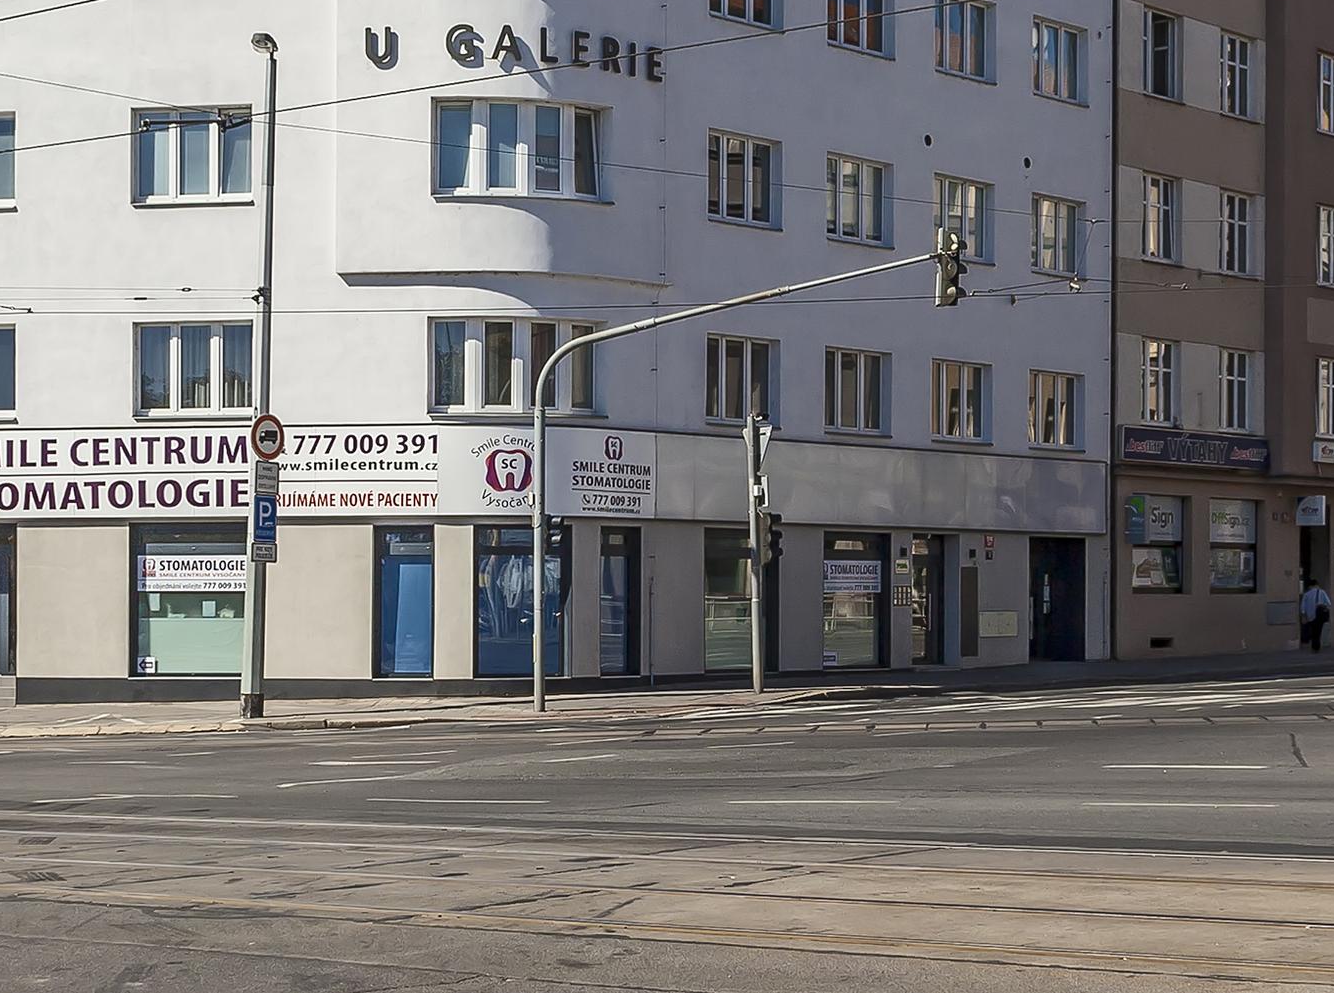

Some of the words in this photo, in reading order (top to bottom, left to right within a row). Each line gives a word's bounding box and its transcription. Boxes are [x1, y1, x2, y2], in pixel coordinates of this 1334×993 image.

[365, 26, 394, 63] U
[446, 24, 664, 83] GALERIE
[70, 436, 249, 467] CENTRUM
[293, 435, 337, 455] 777
[344, 434, 389, 455] 009
[395, 434, 438, 455] 391
[471, 437, 500, 458] Smile
[503, 435, 536, 452] Centr
[279, 459, 438, 472] ww.smilecentrum.cz
[501, 458, 517, 469] SC
[572, 461, 605, 474] SMILE
[607, 463, 651, 476] CENTRUM
[572, 475, 651, 490] STOMATOLOGIE
[276, 491, 336, 508] IJÍMÁME
[340, 490, 374, 508] NOVÉ
[378, 493, 438, 508] PACIENTY
[481, 489, 534, 509] Vysočan
[593, 494, 608, 506] 777
[610, 495, 626, 507] 009
[627, 496, 641, 507] 391
[259, 501, 272, 526] P
[159, 560, 245, 571] STOMATOLOGIE
[830, 564, 878, 575] STOMATOLOGIE
